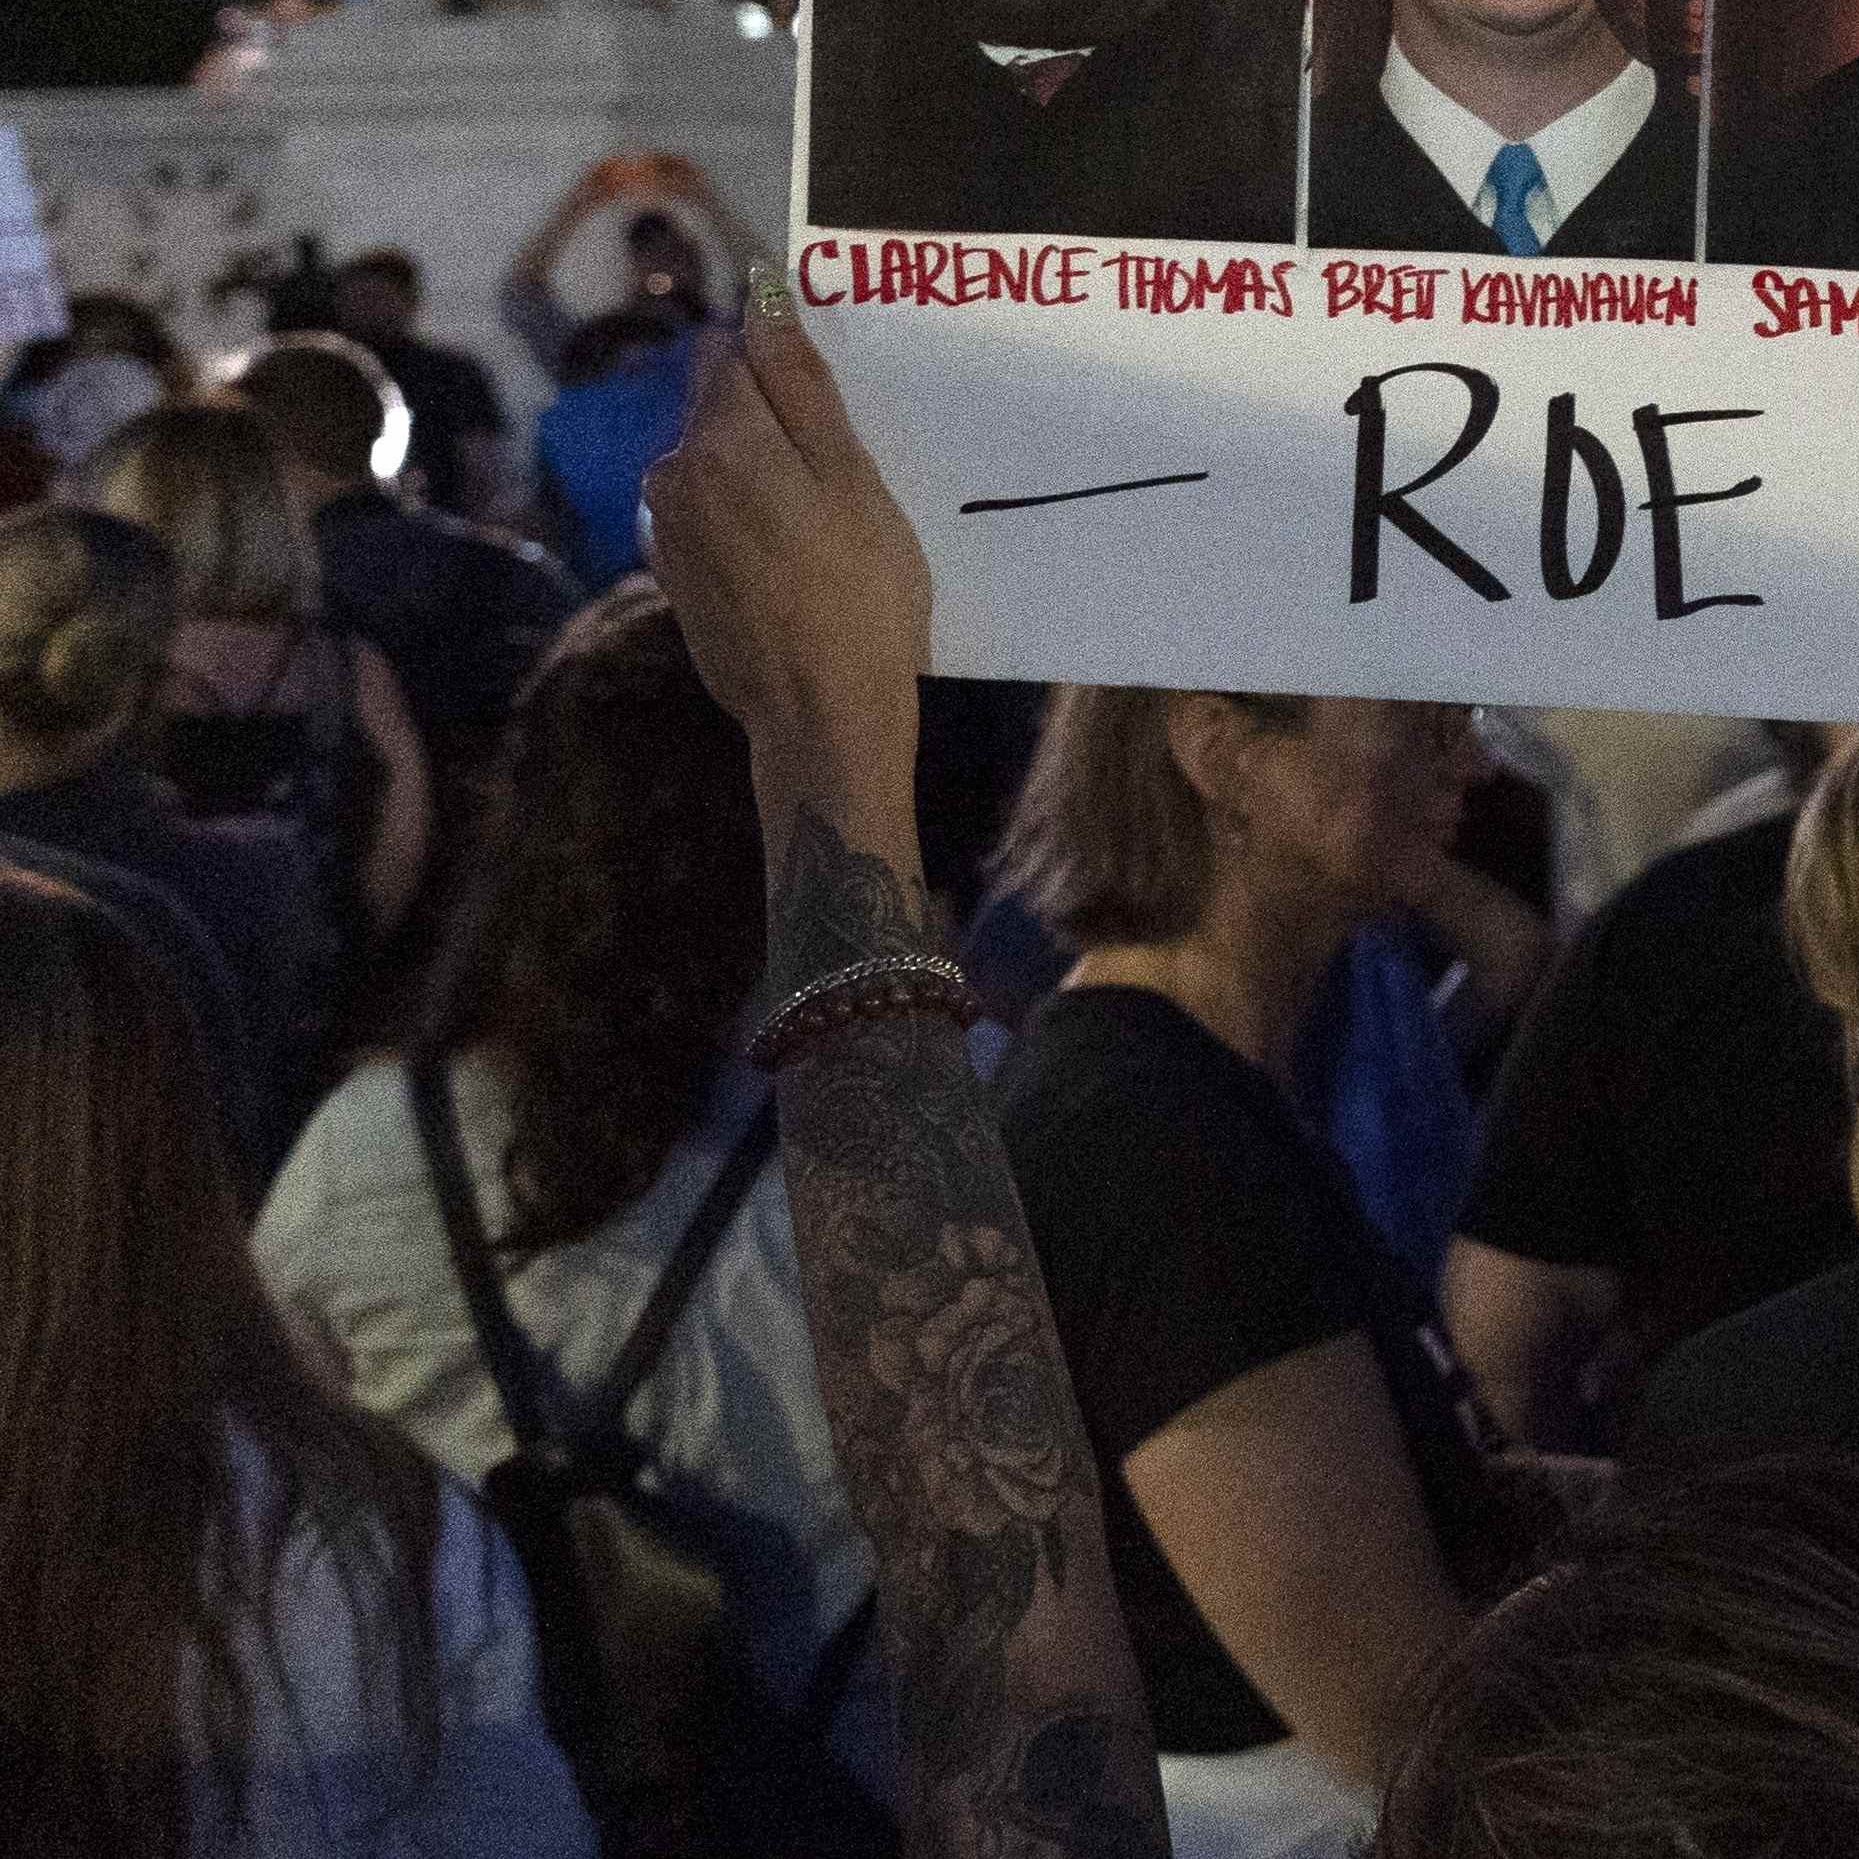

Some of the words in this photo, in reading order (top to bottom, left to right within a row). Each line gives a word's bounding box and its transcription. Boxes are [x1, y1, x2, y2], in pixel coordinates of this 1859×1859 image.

[800, 238, 1089, 306] CLARENCE
[1105, 252, 1293, 317] THOMAS
[1322, 260, 1441, 324] BRETT
[1345, 364, 1763, 620] ROE
